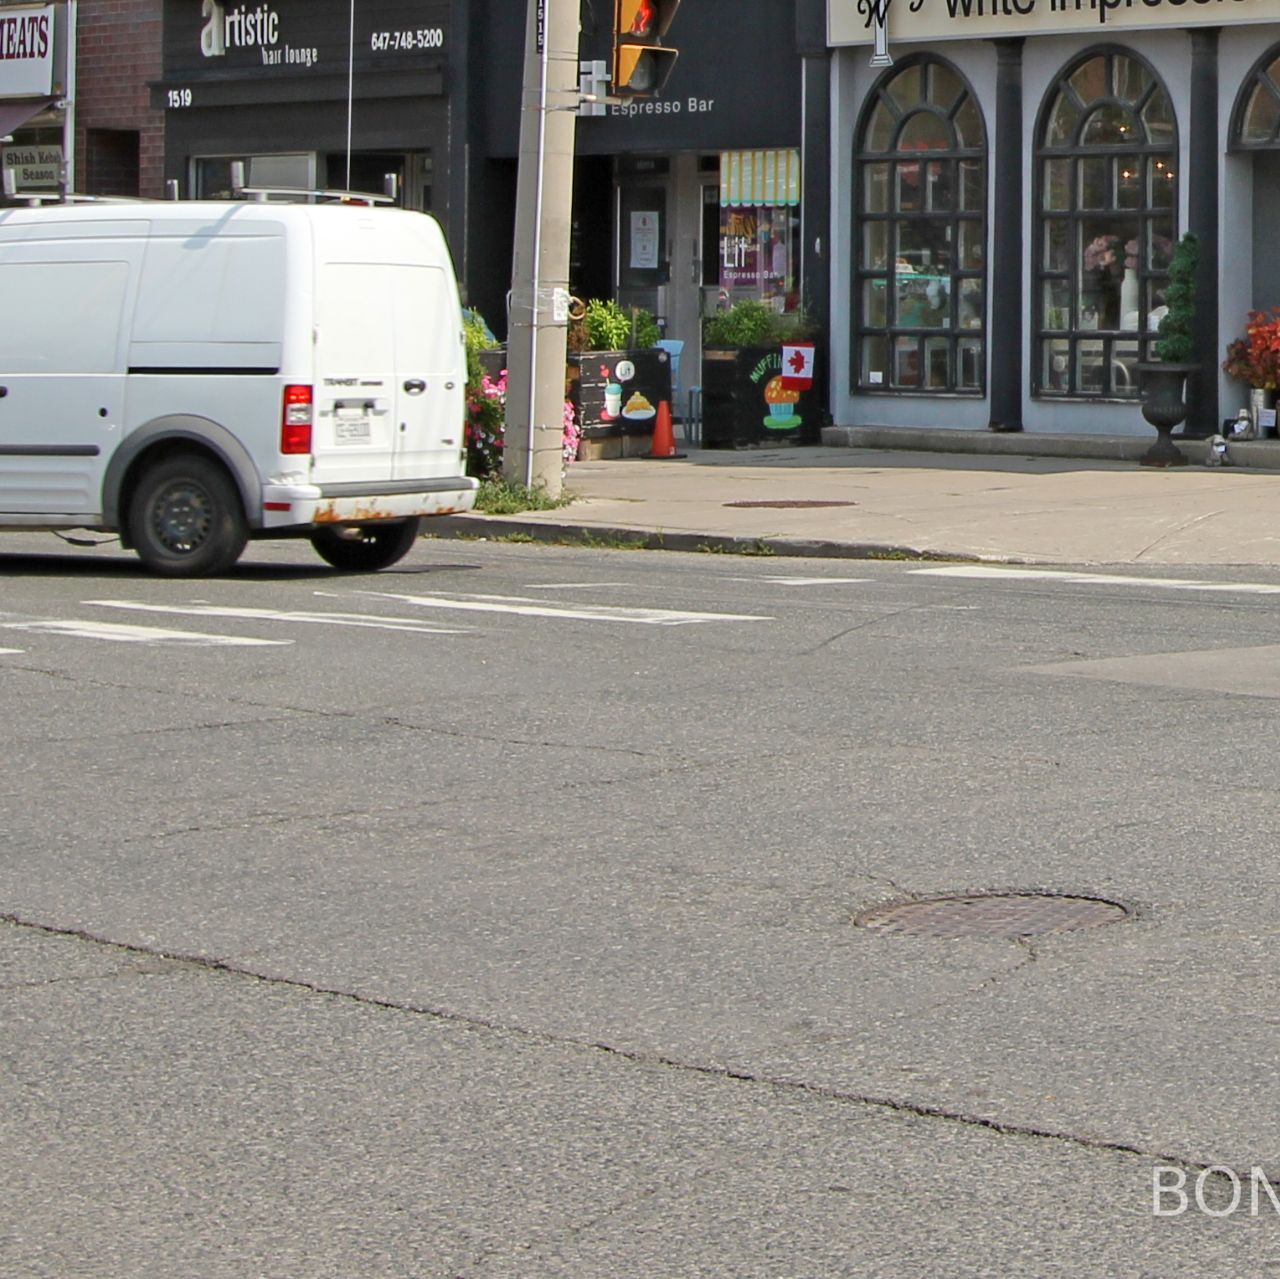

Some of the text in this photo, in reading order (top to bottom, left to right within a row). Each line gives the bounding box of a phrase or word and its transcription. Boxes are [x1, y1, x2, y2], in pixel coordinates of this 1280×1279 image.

[0, 14, 49, 61] EATS
[371, 28, 443, 51] 647-748-5200
[261, 45, 318, 67] hair lounge
[168, 88, 192, 108] 1519
[611, 97, 714, 118] Espresso Bar
[6, 151, 36, 166] Shish
[22, 168, 55, 181] Season
[723, 236, 745, 268] Lit
